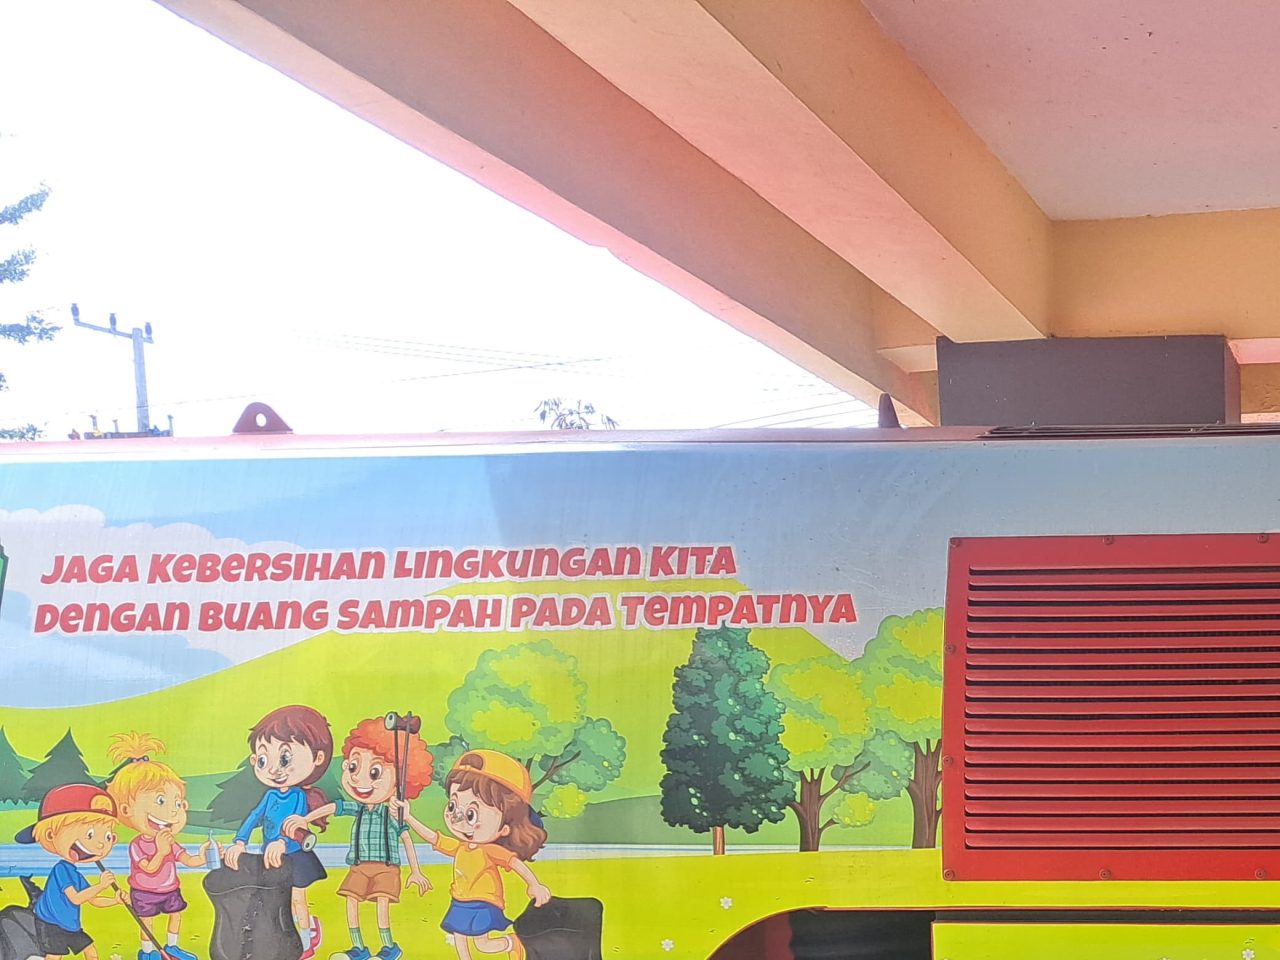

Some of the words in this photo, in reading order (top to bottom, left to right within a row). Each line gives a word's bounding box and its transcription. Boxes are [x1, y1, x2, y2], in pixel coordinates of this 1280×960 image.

[40, 553, 139, 585] JAGA
[649, 545, 737, 577] KITA
[336, 597, 502, 630] SAMPAH
[510, 596, 612, 628] PADA
